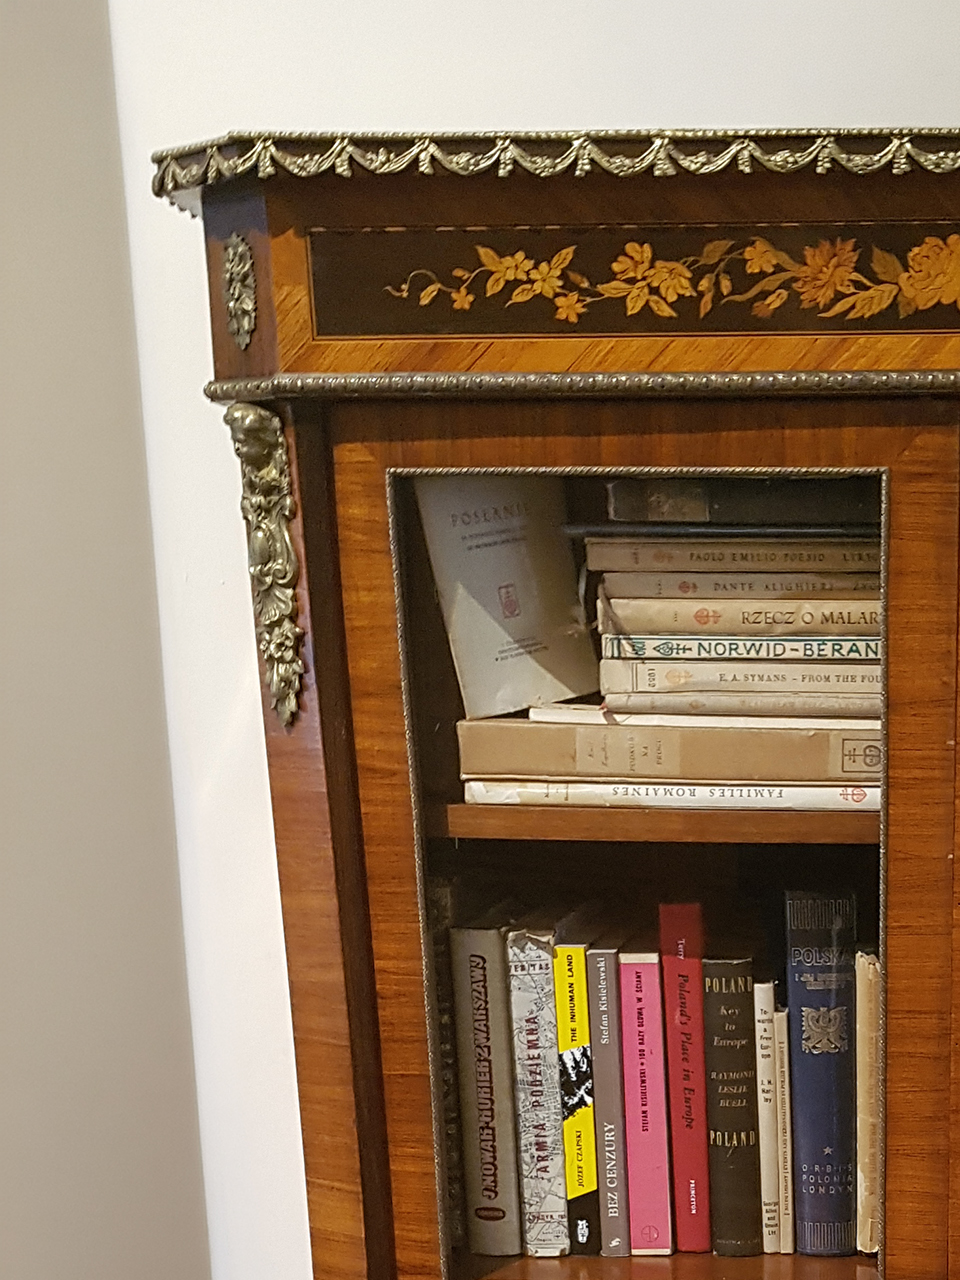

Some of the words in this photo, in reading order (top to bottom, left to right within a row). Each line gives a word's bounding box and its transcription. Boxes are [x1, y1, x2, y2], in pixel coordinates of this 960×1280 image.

[732, 552, 777, 562] EMILIO
[714, 582, 754, 592] DANTE
[741, 611, 796, 625] RZECZ
[801, 611, 814, 625] O
[820, 611, 880, 625] MALAR
[718, 673, 727, 682] E.
[731, 673, 741, 682] A.
[744, 673, 786, 683] SYMANS
[801, 674, 831, 683] FROM
[835, 674, 857, 683] THE
[611, 787, 697, 798] ROMAINES
[709, 789, 784, 799] FAMILLES
[677, 938, 686, 960] Terry
[791, 947, 853, 966] POLSKA
[565, 954, 575, 979] LAND
[595, 957, 609, 1011] Kisielewski
[704, 976, 753, 994] POLAND
[567, 982, 577, 1023] INHUMAN
[677, 974, 689, 1027] Poland's
[719, 1005, 741, 1018] Key
[569, 1026, 578, 1042] THE
[599, 1013, 610, 1044] Stefan
[724, 1022, 736, 1031] to
[679, 1031, 692, 1063] Place
[713, 1036, 749, 1049] Europe
[526, 1015, 545, 1108] PODZIEMNA
[682, 1068, 692, 1082] in
[710, 1071, 755, 1081] RAYMOND
[638, 1068, 648, 1107] KISIELEWSKI
[717, 1084, 748, 1094] LESLIE
[682, 1087, 696, 1130] Europe
[640, 1109, 649, 1132] STEFAN
[533, 1122, 550, 1175] ARMIA
[574, 1130, 584, 1163] CZAPSKI
[709, 1130, 756, 1147] POLAND
[603, 1122, 618, 1188] CENZURY
[575, 1164, 585, 1189] JÓZEF
[606, 1191, 619, 1217] BEZ
[689, 1179, 697, 1214] PRINCETON
